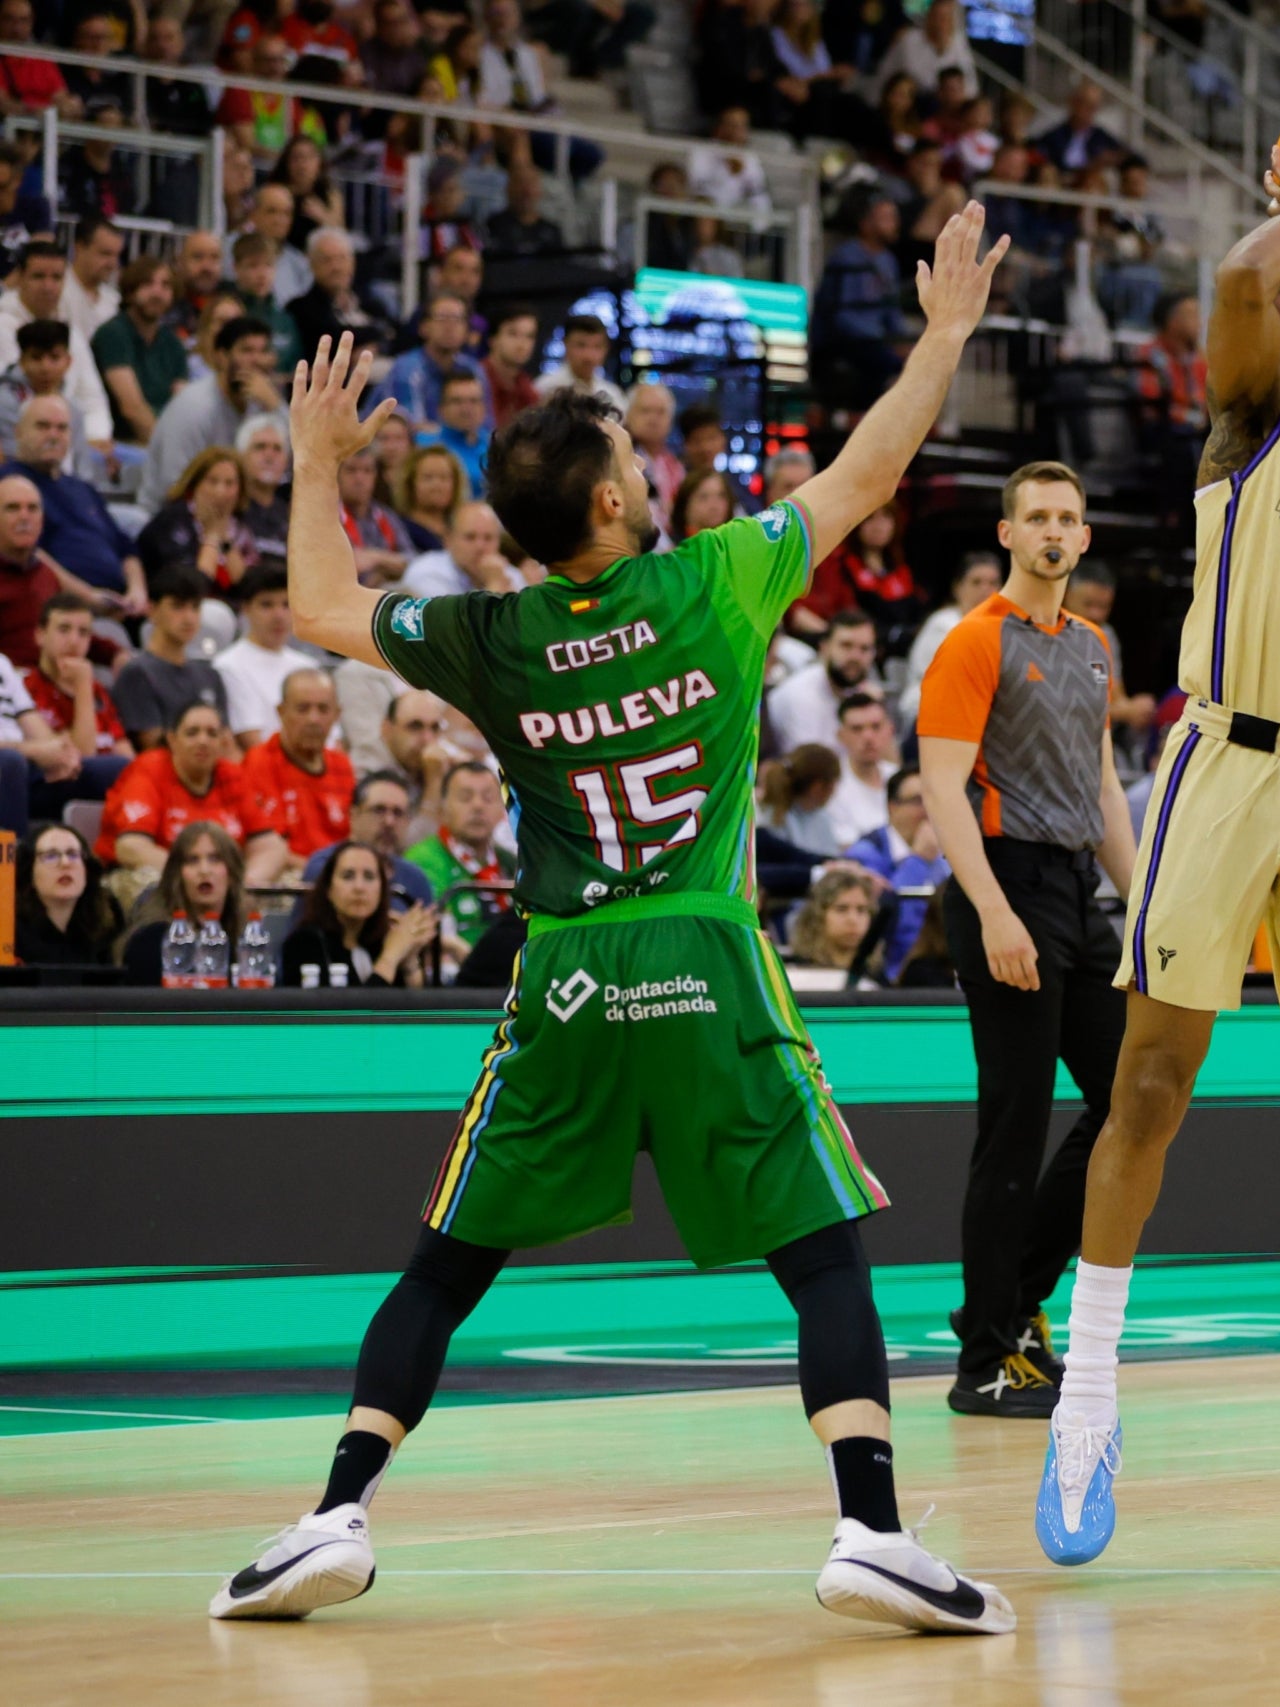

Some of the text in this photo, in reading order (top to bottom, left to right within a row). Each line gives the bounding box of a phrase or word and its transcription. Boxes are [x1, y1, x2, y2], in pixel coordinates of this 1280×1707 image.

[546, 620, 657, 673] COSTA
[519, 669, 717, 748] PULEVA
[567, 739, 709, 873] 15
[604, 974, 708, 1005] Dputación
[627, 996, 717, 1021] Granada
